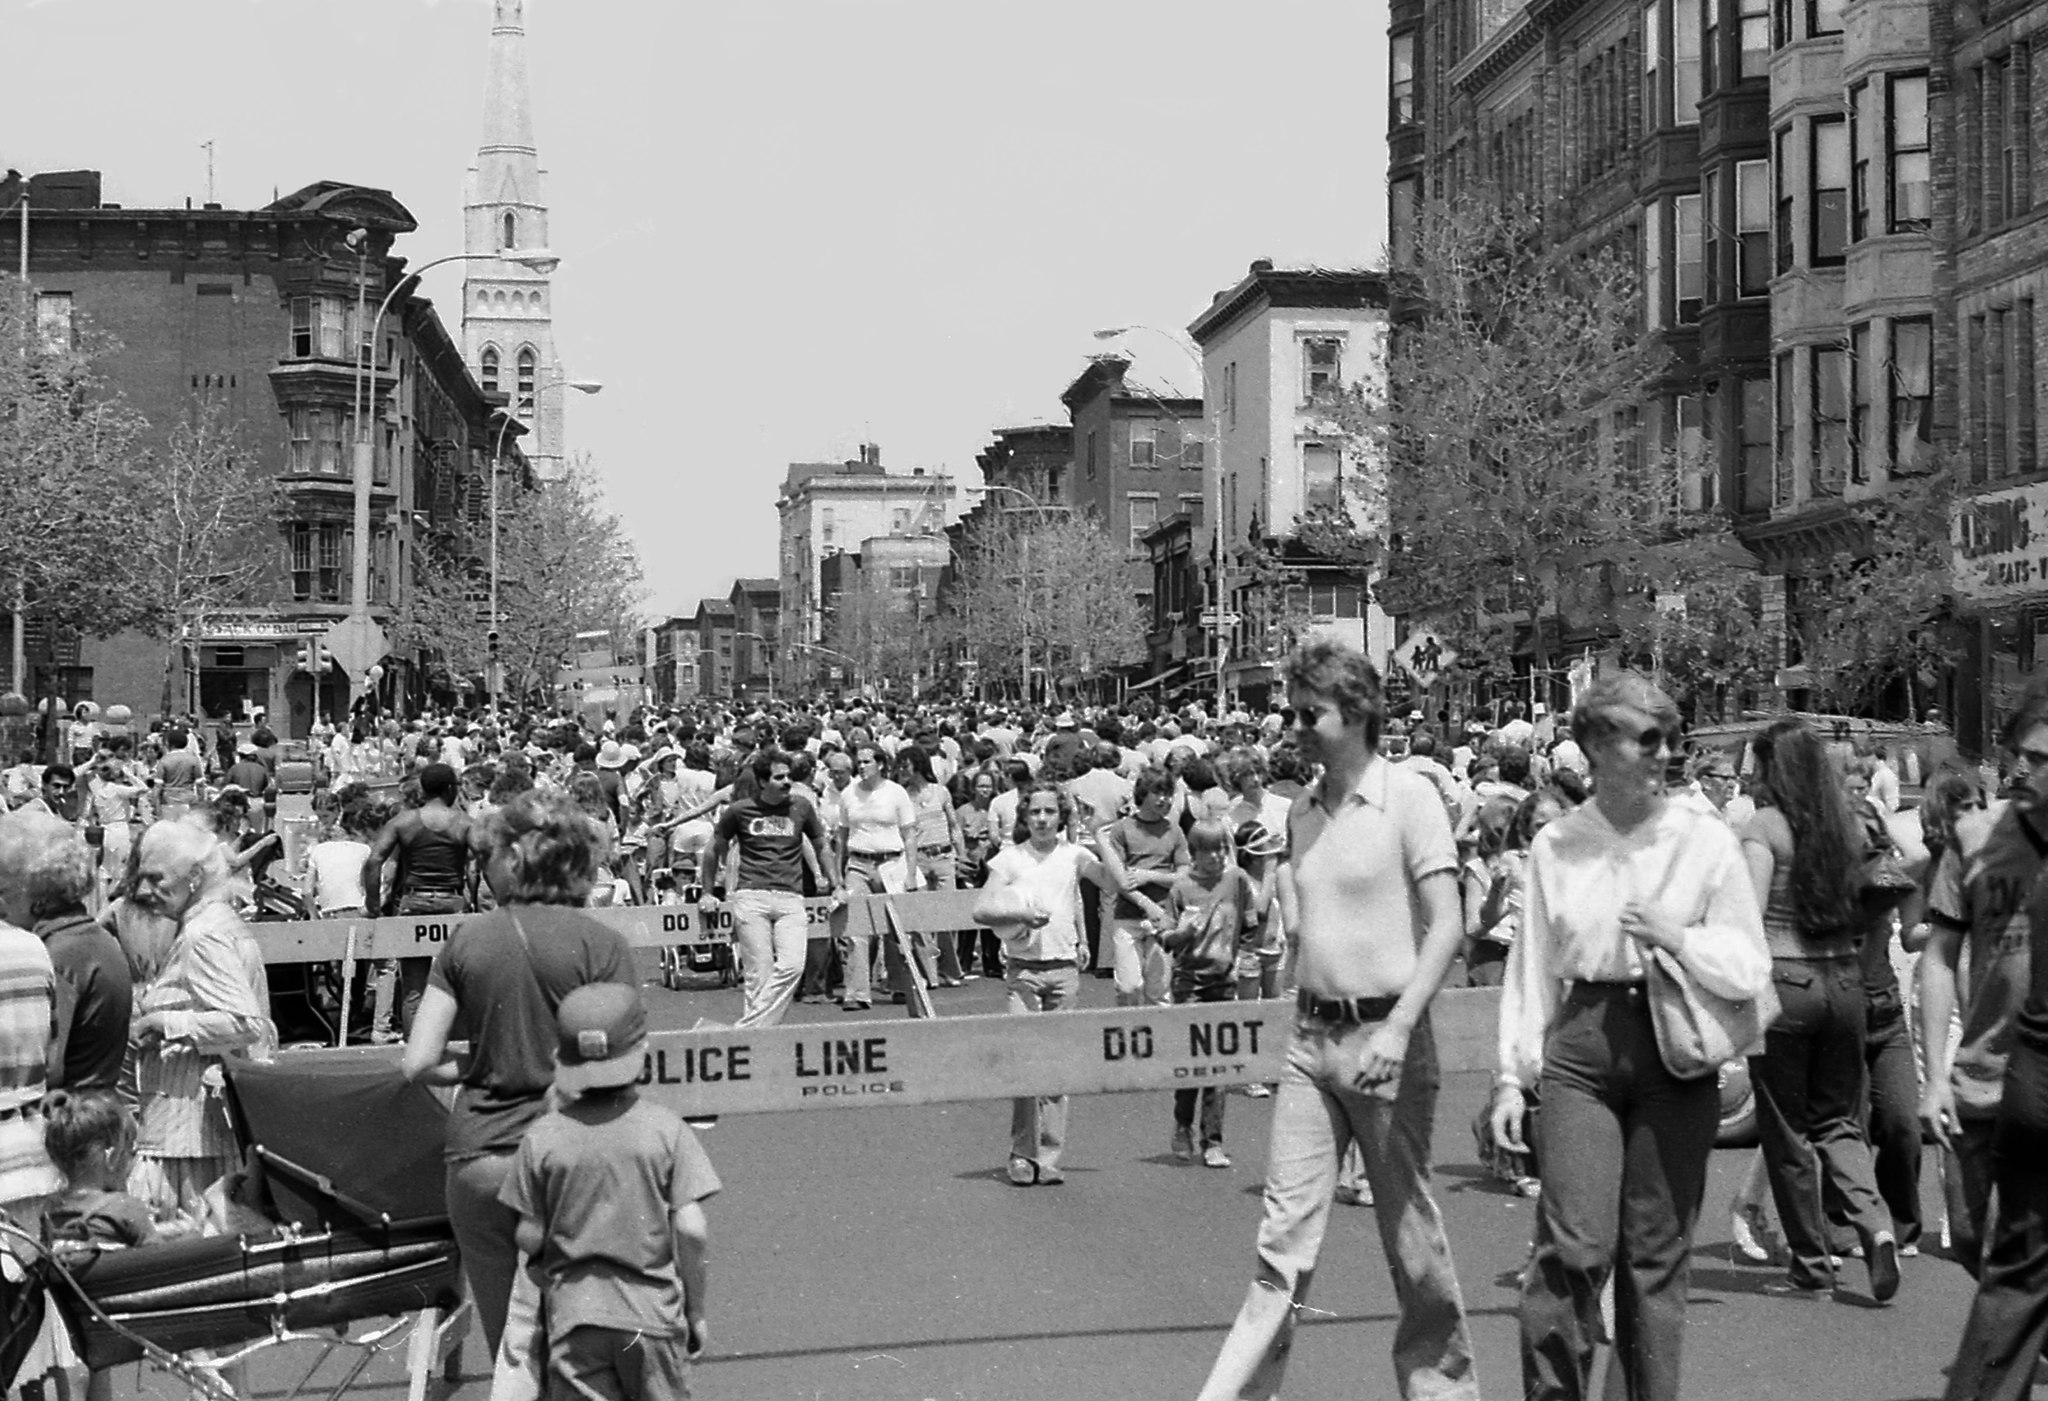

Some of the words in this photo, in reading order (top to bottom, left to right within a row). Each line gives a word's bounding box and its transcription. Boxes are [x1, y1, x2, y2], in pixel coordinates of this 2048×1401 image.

[663, 913, 690, 932] DO
[706, 911, 732, 930] NO
[634, 1046, 751, 1084] LICE
[796, 1038, 888, 1077] LINE
[1103, 1025, 1154, 1061] DO
[1190, 1020, 1264, 1057] NOT
[802, 1080, 905, 1097] POLICE
[1173, 1063, 1246, 1078] DEPT
